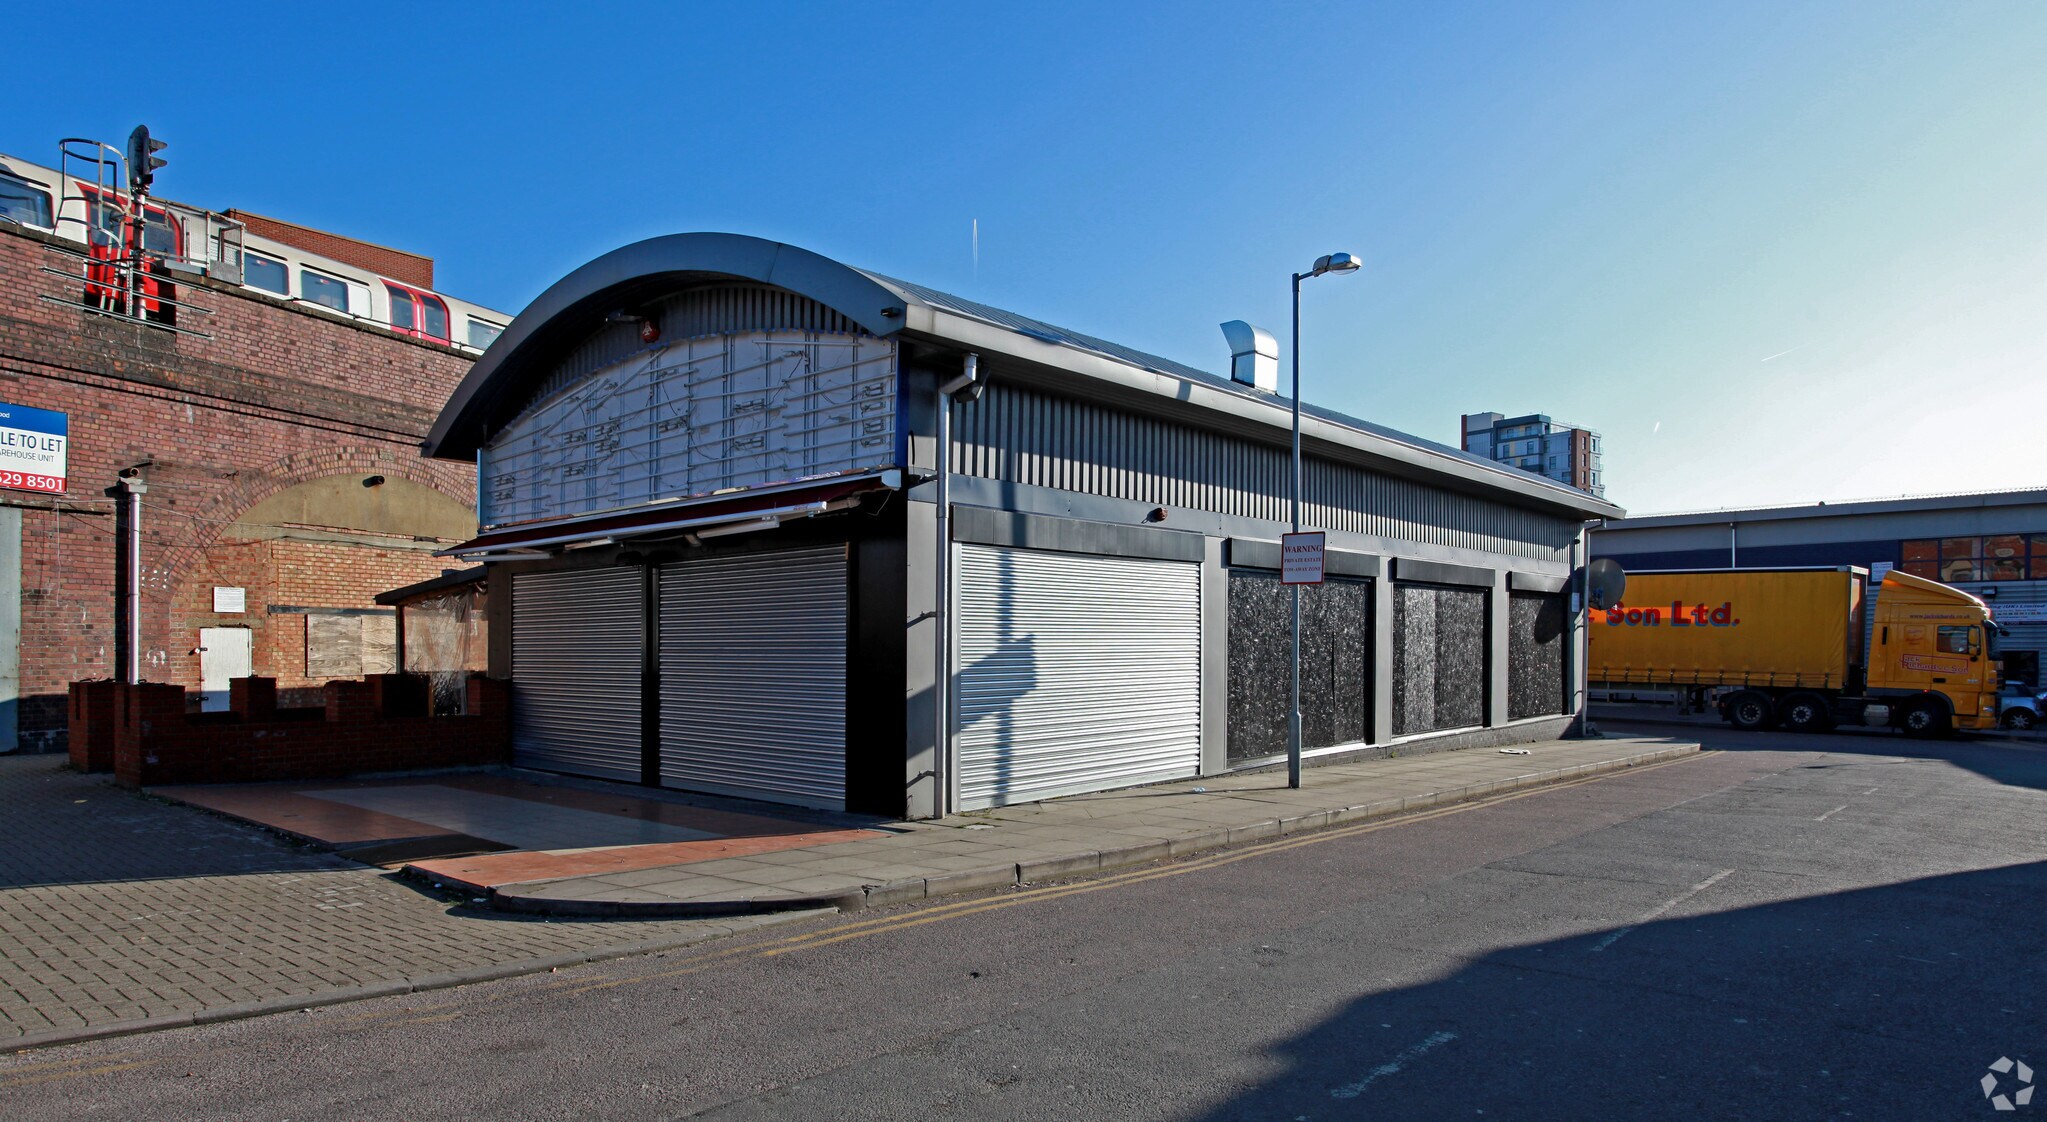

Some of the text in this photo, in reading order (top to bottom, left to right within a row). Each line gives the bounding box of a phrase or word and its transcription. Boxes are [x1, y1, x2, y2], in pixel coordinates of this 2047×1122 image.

[41, 437, 62, 452] LET
[38, 453, 54, 462] UNIT
[27, 475, 63, 491] 8501
[1285, 545, 1322, 553] WARNING
[1607, 601, 1660, 626] Son
[1671, 600, 1740, 627] Ltd.
